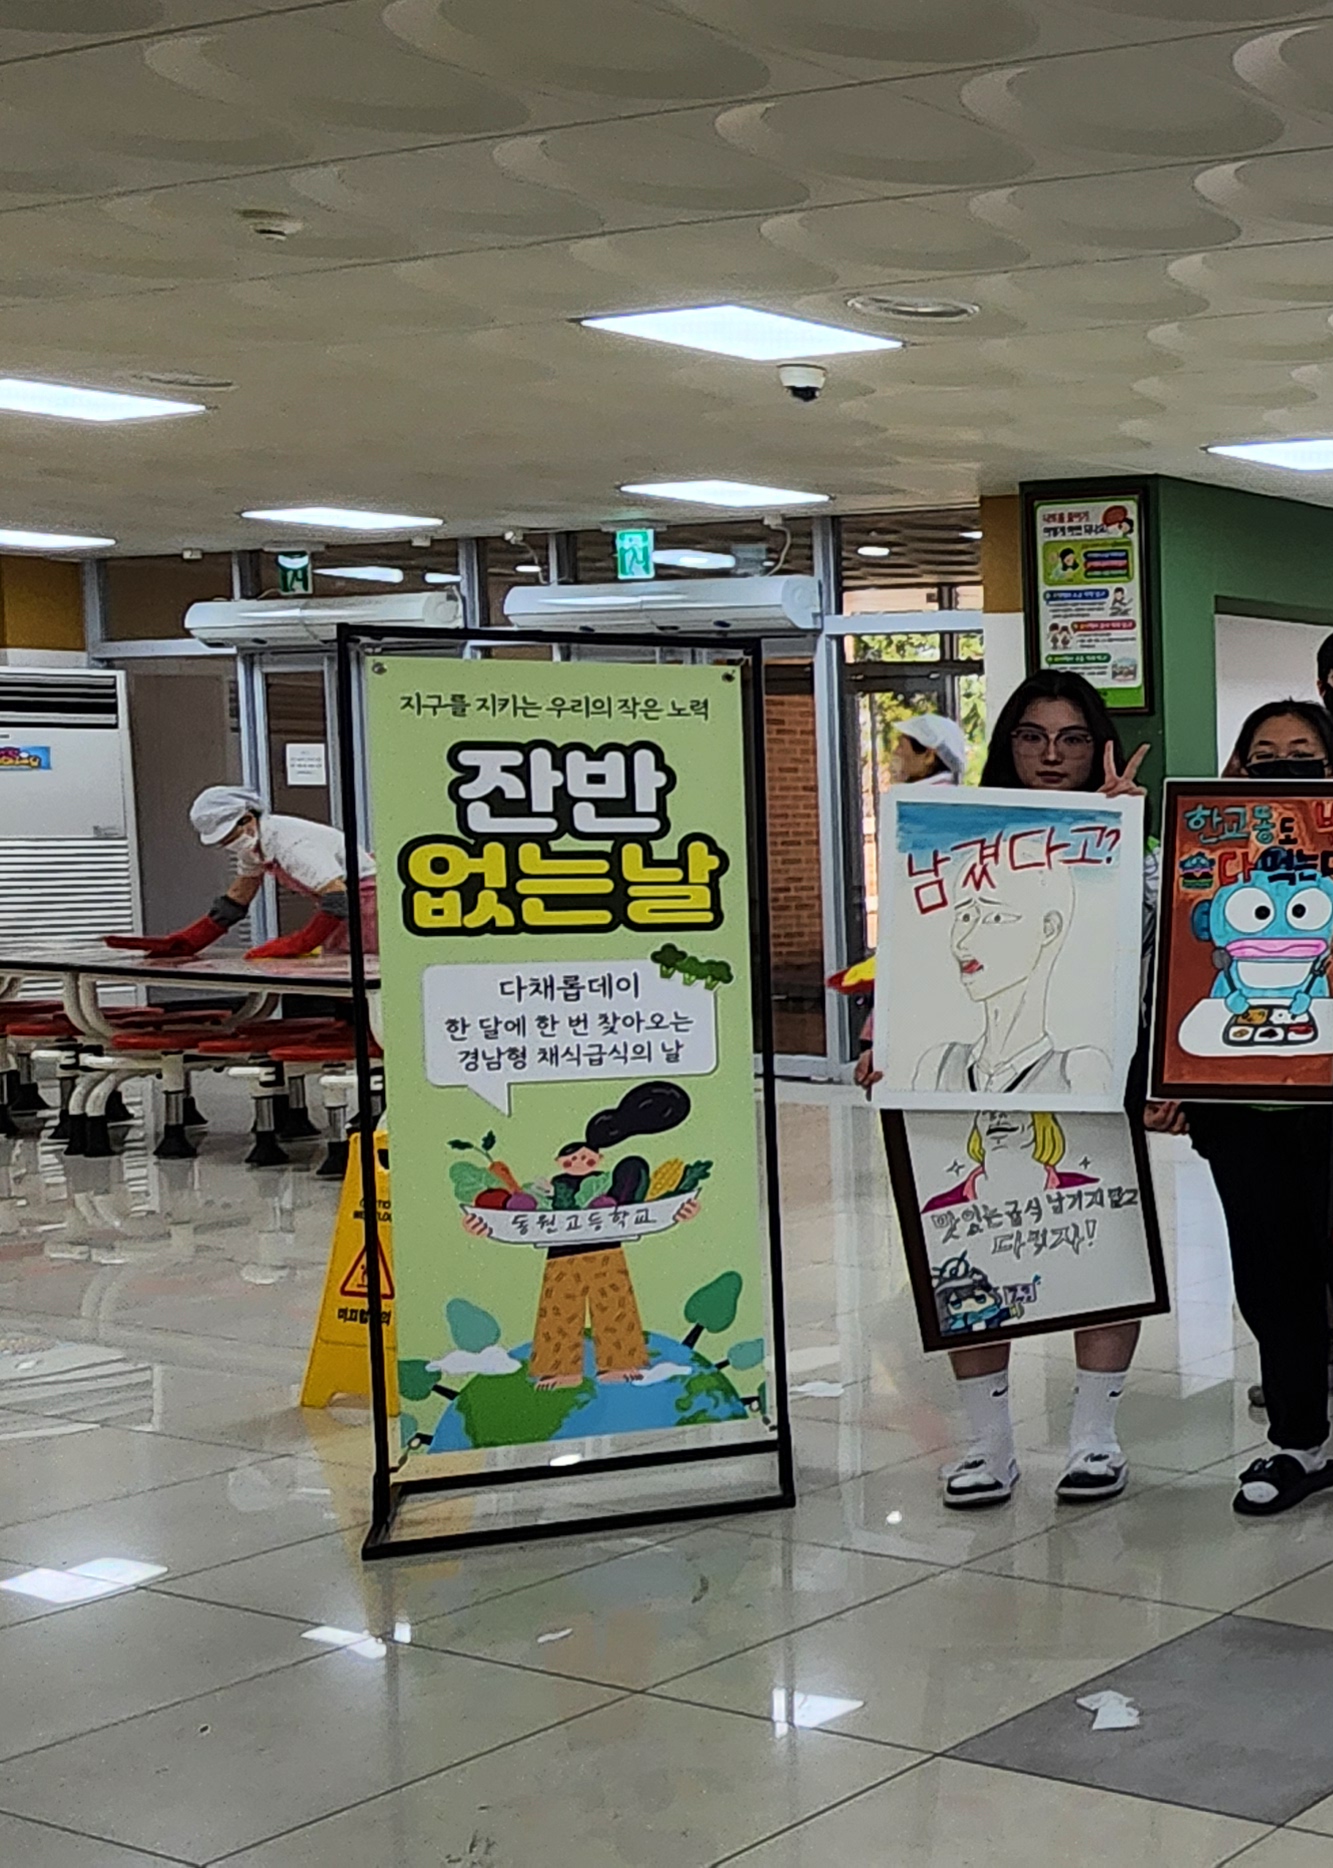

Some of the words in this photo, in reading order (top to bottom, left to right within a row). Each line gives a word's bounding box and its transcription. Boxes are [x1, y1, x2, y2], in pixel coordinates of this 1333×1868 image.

[400, 692, 471, 717] 지구를
[475, 693, 543, 718] 지키는
[546, 694, 613, 719] 우리의
[617, 696, 664, 720] 작은
[666, 697, 710, 721] 노력
[454, 743, 672, 836] 잔반
[908, 826, 1122, 914] 남겼다고?
[499, 971, 640, 1003] 다채롭데이
[445, 1016, 471, 1042] 한
[478, 1015, 527, 1040] 달에
[534, 1013, 560, 1038] 한
[567, 1012, 589, 1037] 번
[597, 1010, 694, 1037] 찾아오는
[457, 1046, 527, 1073] 경남형
[536, 1041, 653, 1069] 채식급식의
[660, 1039, 685, 1065] 날
[511, 1206, 657, 1237] 동원고등학교
[931, 1203, 1004, 1244] 맛있는
[1004, 1196, 1043, 1227] 급식
[1046, 1190, 1106, 1215] 남기지
